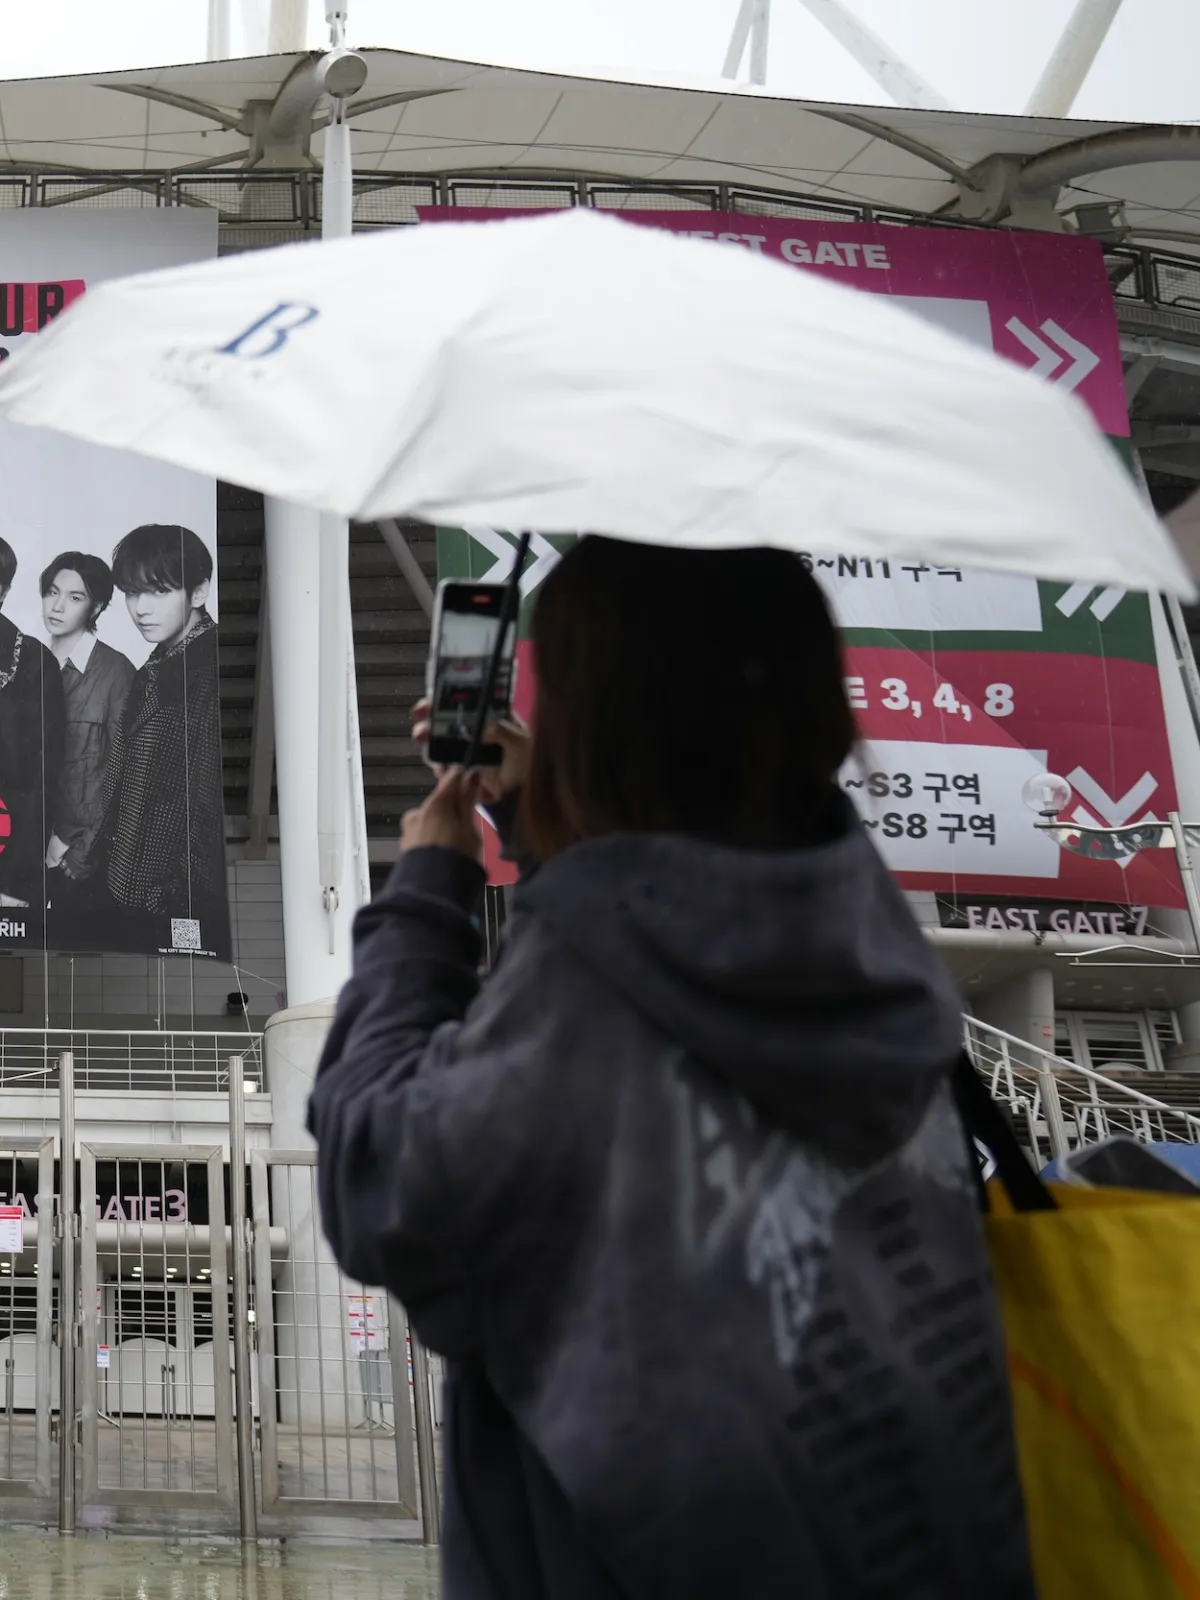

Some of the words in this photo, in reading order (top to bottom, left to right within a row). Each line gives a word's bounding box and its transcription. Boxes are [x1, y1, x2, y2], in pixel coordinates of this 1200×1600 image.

[780, 238, 891, 269] GATE
[216, 300, 320, 359] B
[880, 678, 922, 718] 3,
[933, 683, 972, 722] 4,
[984, 683, 1015, 717] 8
[923, 772, 981, 805] 구역
[937, 813, 996, 845] 구역
[966, 906, 1039, 931] EAST
